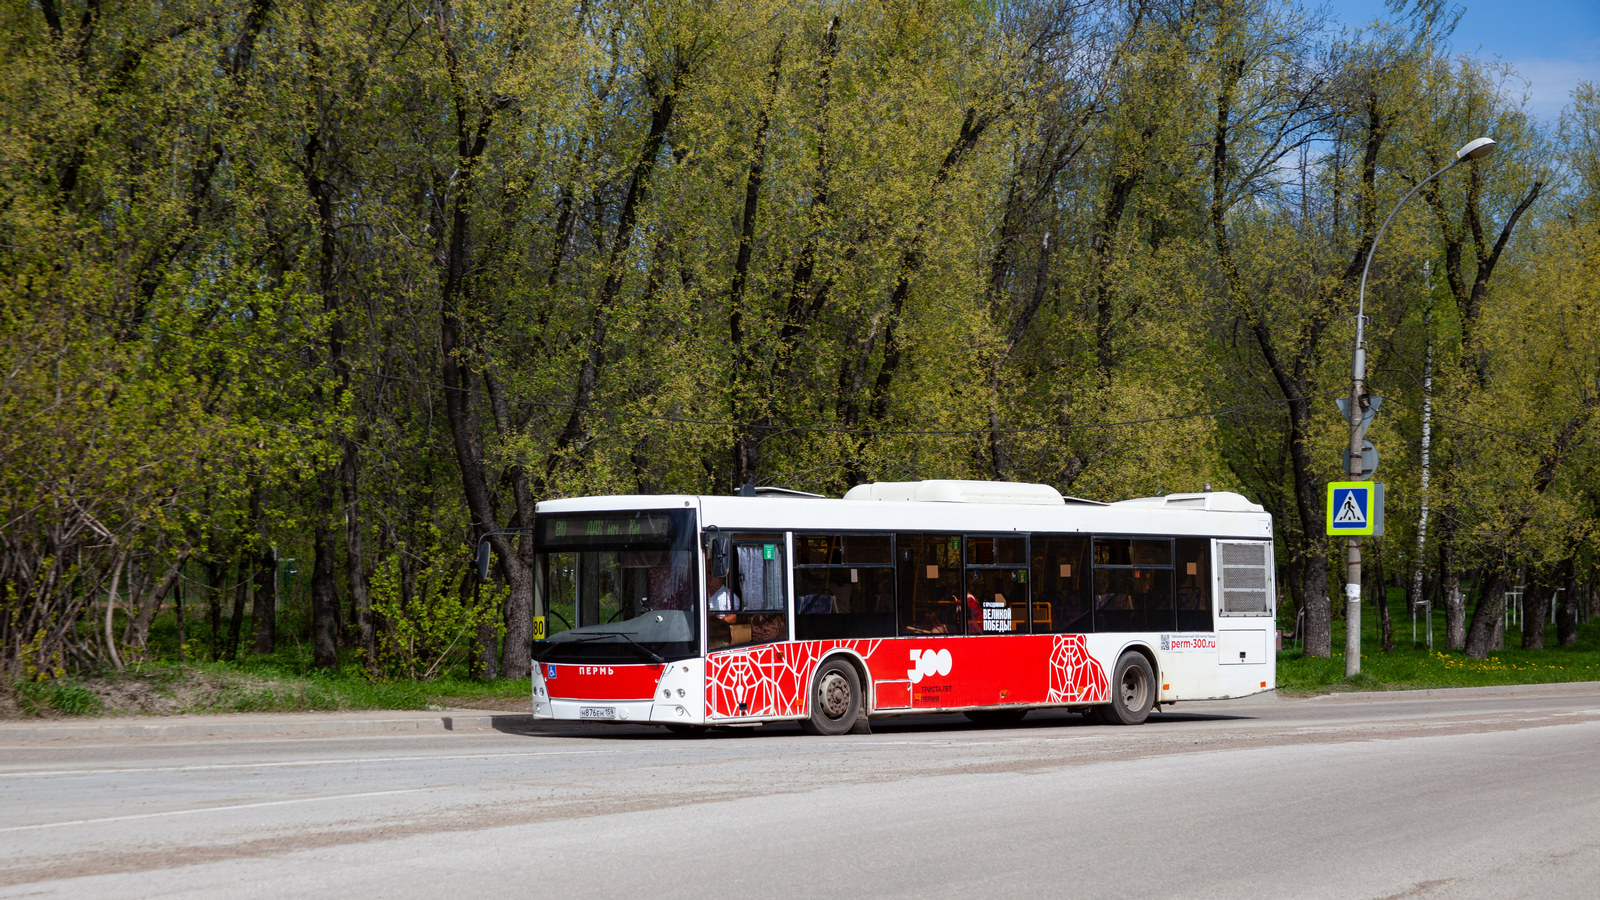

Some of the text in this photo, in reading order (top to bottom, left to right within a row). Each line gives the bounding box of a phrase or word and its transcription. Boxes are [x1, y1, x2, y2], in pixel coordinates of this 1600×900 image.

[555, 520, 567, 536] 80
[983, 608, 1012, 620] ВЕЛИКОЙ
[533, 620, 544, 636] 80
[983, 620, 1012, 632] ПОБЕДЫ!
[1171, 638, 1216, 650] perm-300.ru
[579, 666, 614, 676] ПЕРМЬ
[907, 648, 952, 684] 300
